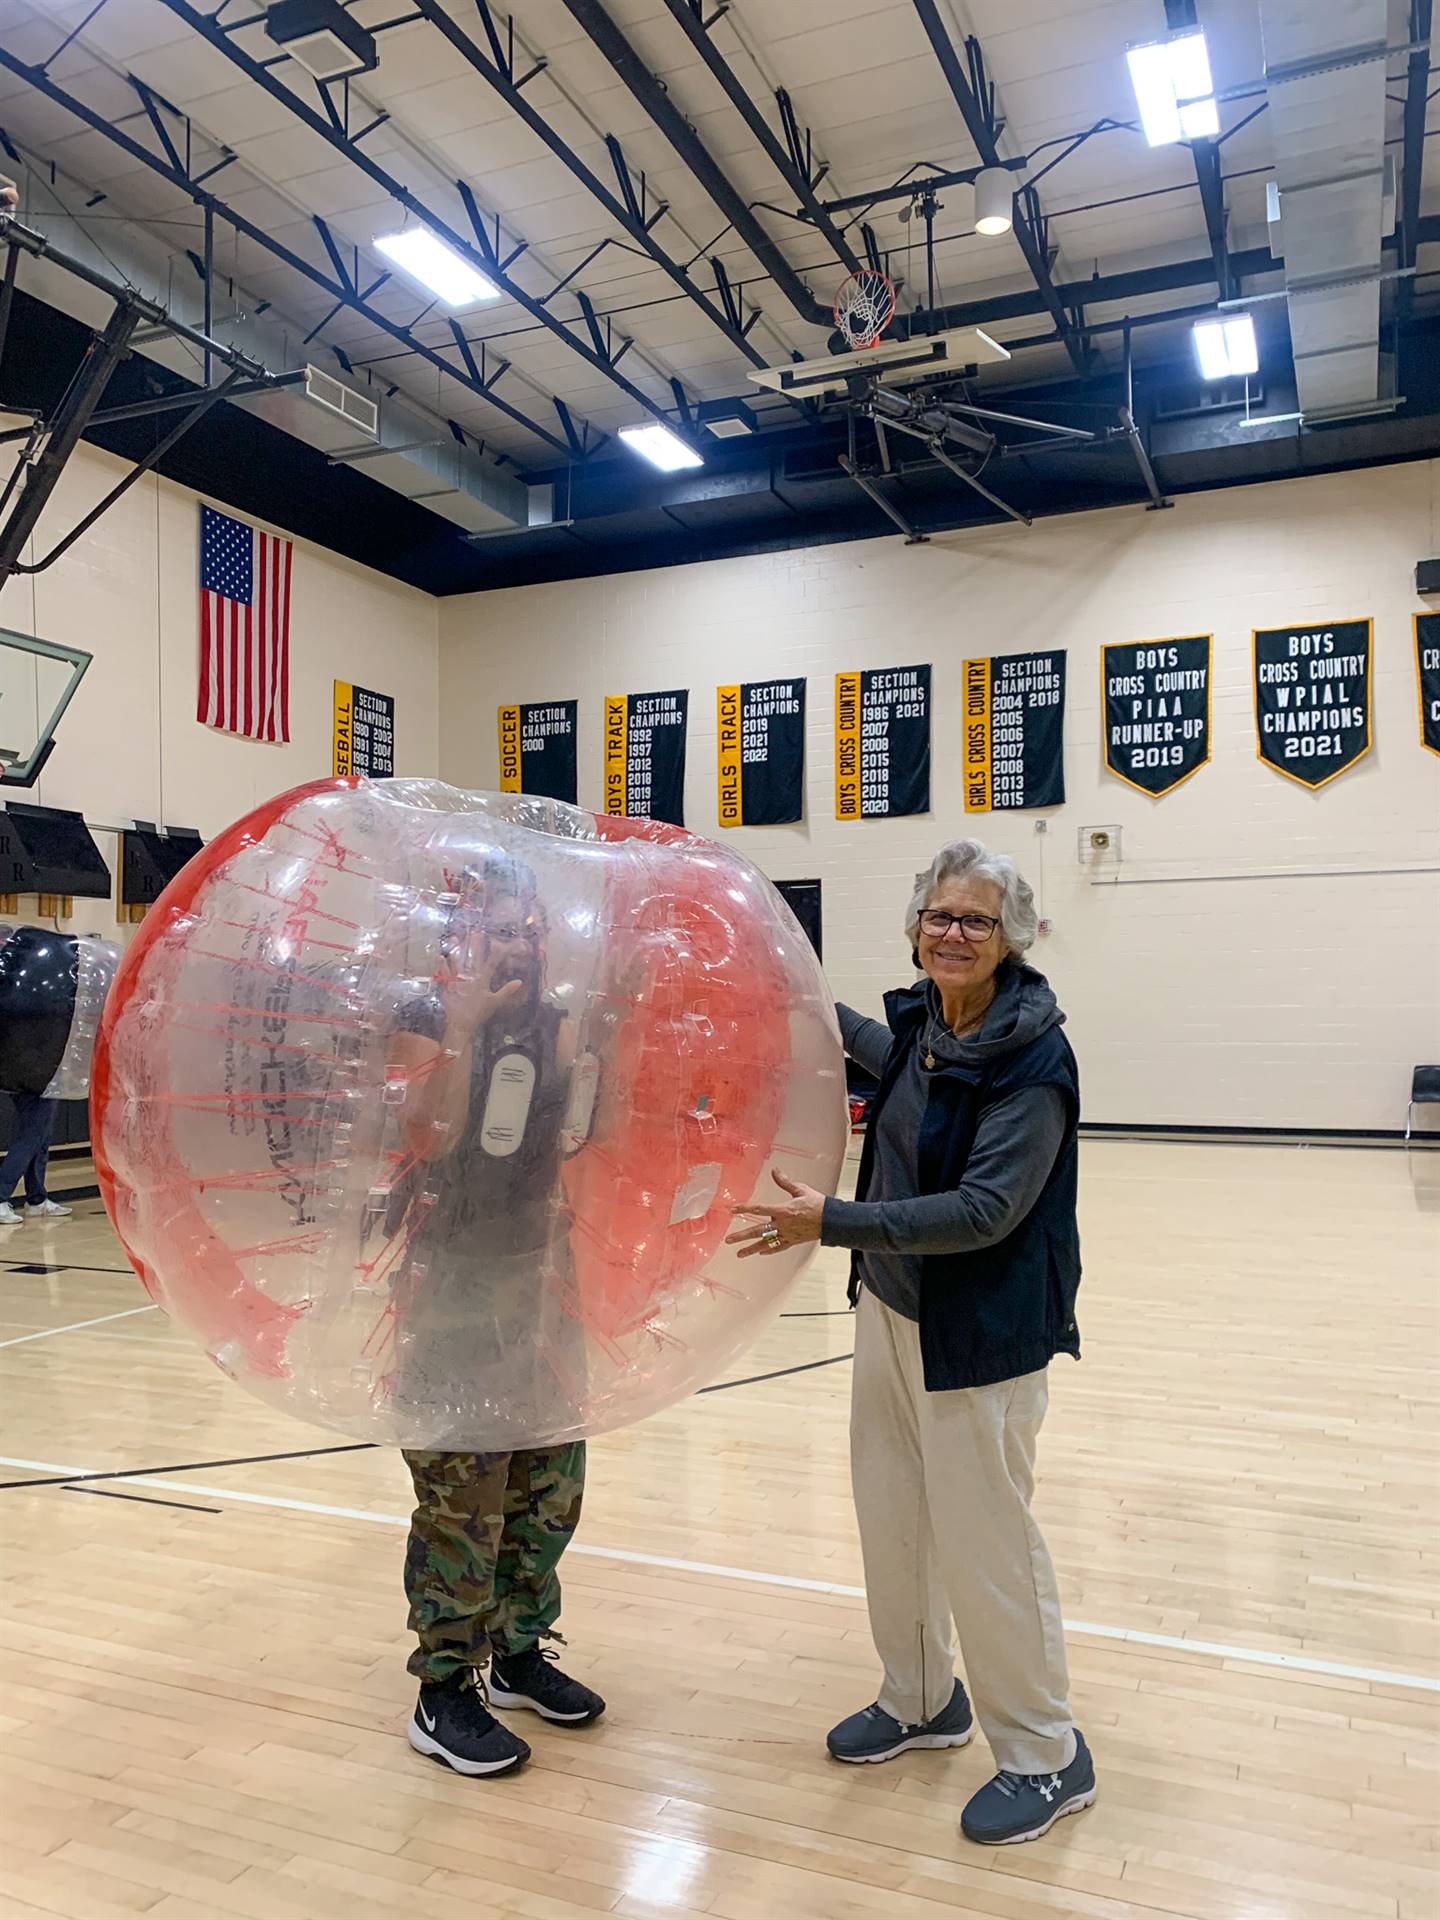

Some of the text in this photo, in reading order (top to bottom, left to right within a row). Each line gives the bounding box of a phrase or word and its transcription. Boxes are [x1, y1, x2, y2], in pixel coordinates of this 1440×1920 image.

[1289, 633, 1334, 656] BOYS
[1136, 648, 1178, 670] BOYS
[1002, 658, 1052, 678] SECTION
[1259, 655, 1365, 683] CROSS COUNTRY
[871, 672, 917, 689] SECTION
[994, 674, 1060, 694] CHAMPIONS
[1109, 670, 1206, 696] CROSS COUNTRY
[750, 685, 792, 702] SECTION
[864, 687, 924, 705] CHAMPIONS
[993, 690, 1060, 711] 2004 2018
[1276, 682, 1349, 707] WPIAL
[359, 693, 387, 714] SECTION
[636, 697, 676, 713] SECTION
[744, 700, 799, 718] CHAMPIONS
[1133, 696, 1182, 719] PIAA
[354, 706, 391, 729] CHAMPIONS
[528, 708, 566, 723] SECTION
[630, 712, 682, 728] CHAMPIONS
[862, 703, 925, 721] 1986 2021
[993, 711, 1024, 727] 2005
[1264, 707, 1363, 733] CHAMPIONS
[522, 721, 571, 737] CHAMPIONS
[743, 718, 768, 733] 2019
[862, 722, 889, 736] 2007
[1112, 719, 1203, 745] RUNNER-UP
[373, 728, 392, 744] 2002
[628, 729, 652, 742] 1992
[743, 733, 768, 748] 2021
[968, 662, 986, 807] GIRLS CROSS COUNTRY
[993, 728, 1024, 742] 2006
[373, 743, 391, 758] 2004
[503, 710, 517, 778] SOCCER
[522, 738, 544, 752] 2000
[628, 743, 652, 757] 1997
[840, 678, 856, 814] BOYS CROSS COUNTRY
[862, 738, 889, 752] 2008
[993, 743, 1024, 758] 2007
[1285, 734, 1342, 757] 2021
[608, 704, 623, 817] BOYS TRACK
[722, 693, 737, 818] GIRLS TRACK
[743, 748, 768, 763] 2022
[862, 753, 889, 767] 2015
[1132, 745, 1183, 768] 2019
[373, 756, 392, 772] 2013
[628, 758, 652, 771] 2012
[993, 760, 1024, 774] 2008
[628, 772, 652, 785] 2018
[862, 769, 889, 782] 2018
[993, 776, 1024, 790] 2013
[628, 786, 652, 800] 2019
[862, 784, 889, 798] 2019
[993, 792, 1024, 806] 2015
[628, 801, 652, 814] 2021
[862, 800, 889, 813] 2020
